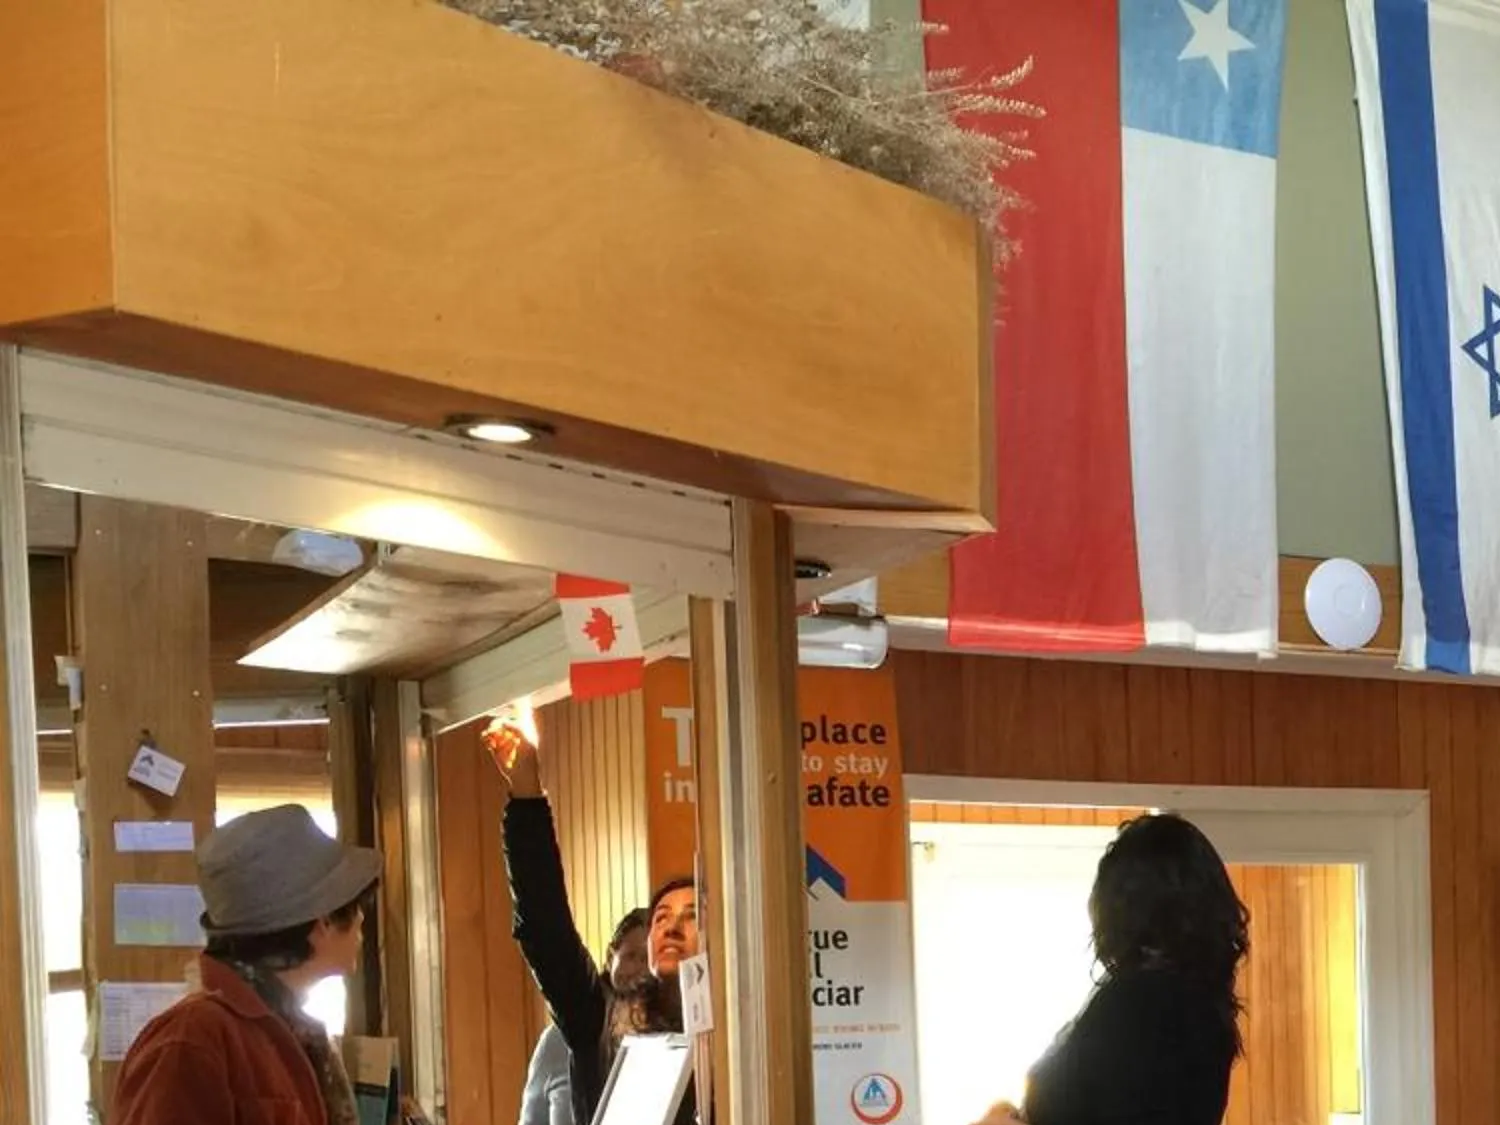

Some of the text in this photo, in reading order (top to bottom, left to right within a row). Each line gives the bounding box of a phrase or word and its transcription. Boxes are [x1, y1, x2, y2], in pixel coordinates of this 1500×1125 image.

[801, 714, 887, 750] place
[801, 752, 888, 777] to stay
[663, 770, 890, 808] in afate
[808, 929, 849, 951] ue
[812, 979, 865, 1008] ciar
